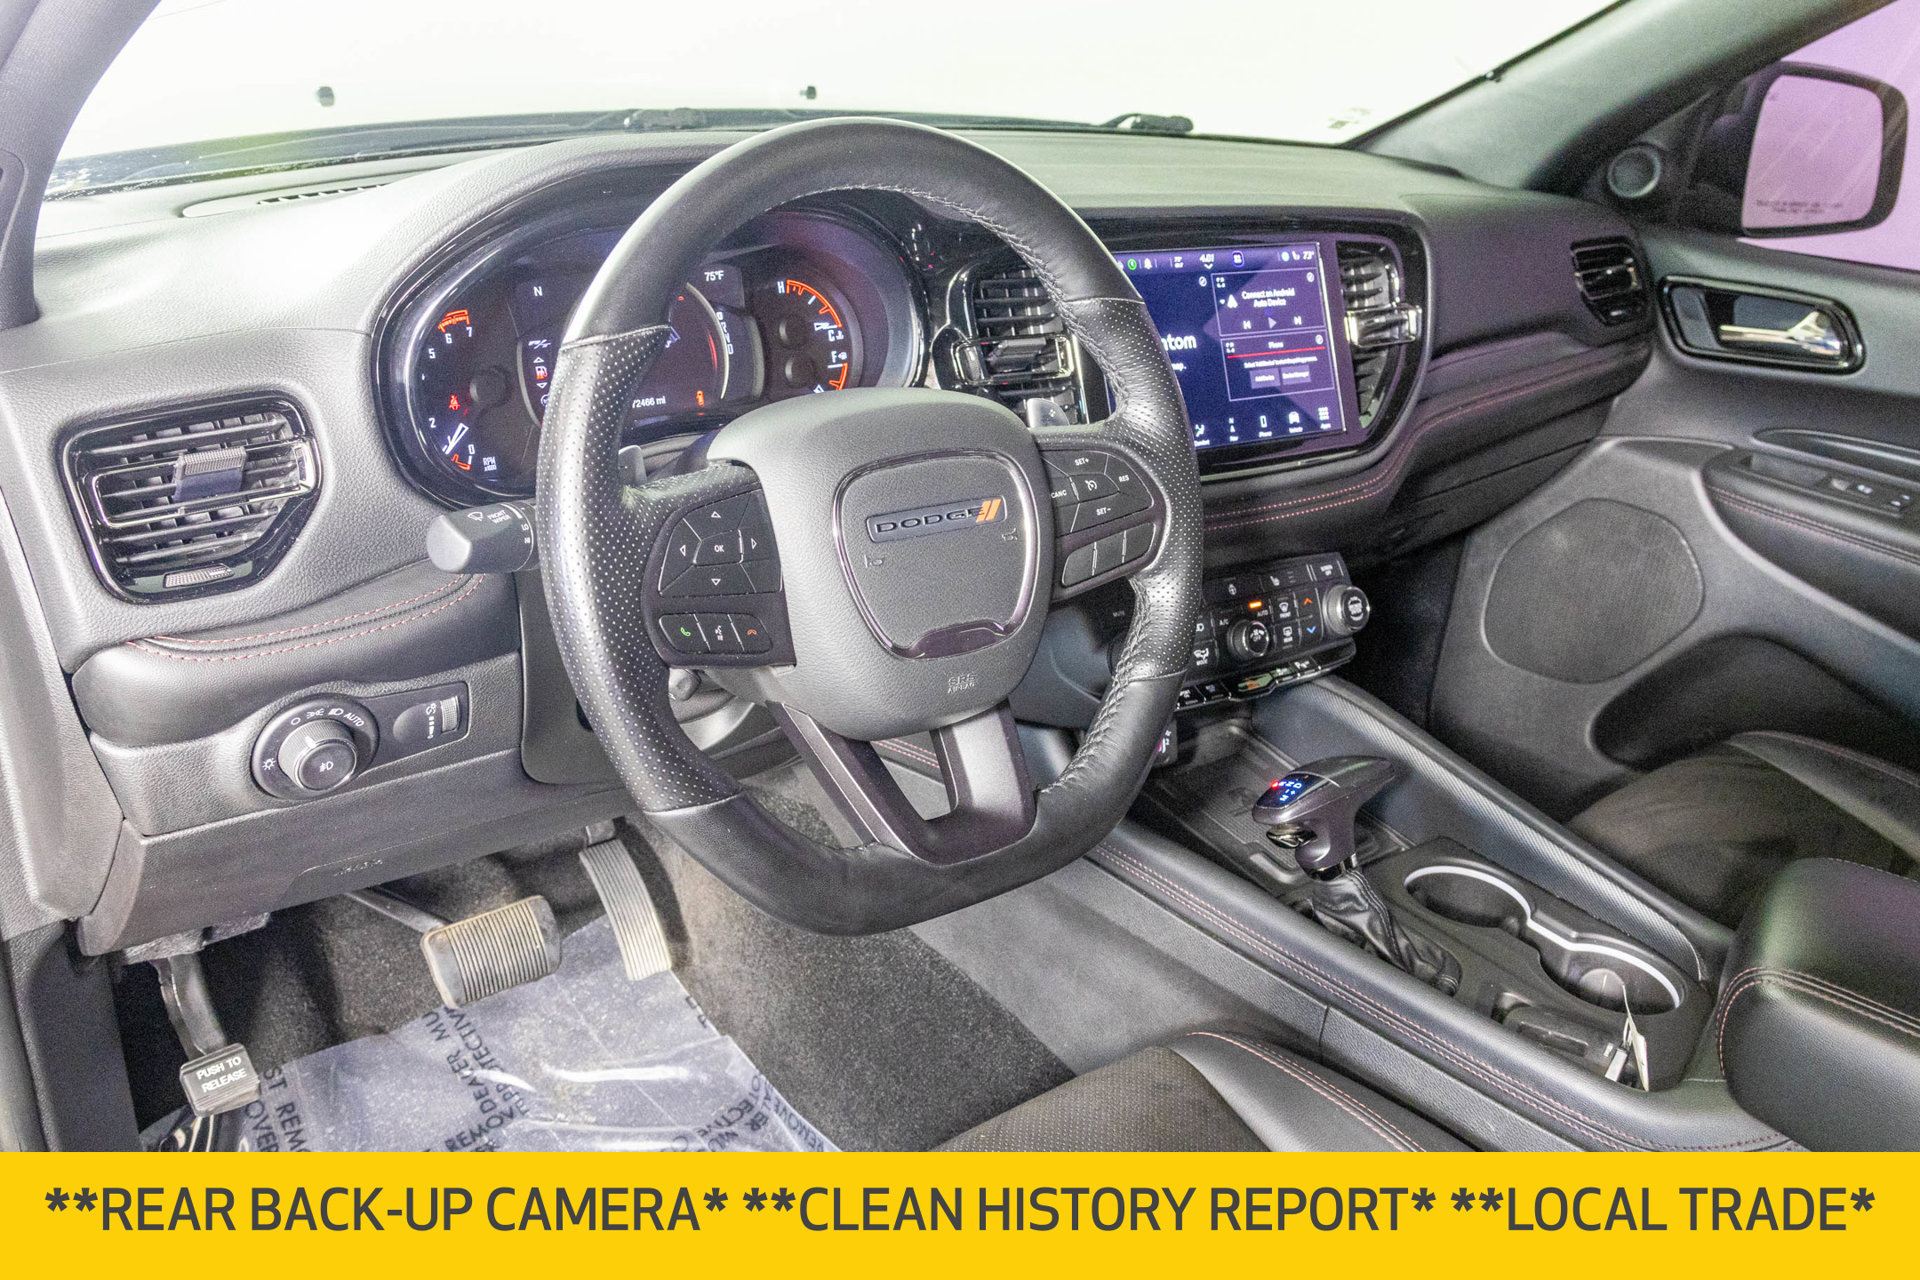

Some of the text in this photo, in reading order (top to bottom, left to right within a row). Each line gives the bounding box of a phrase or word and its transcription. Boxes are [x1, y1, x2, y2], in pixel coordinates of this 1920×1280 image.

[704, 270, 725, 281] 75°F
[533, 286, 543, 296] N
[777, 281, 785, 293] H
[466, 327, 473, 337] 7
[827, 330, 836, 342] C
[445, 333, 453, 344] 6
[428, 348, 436, 359] 5
[831, 351, 837, 363] F
[429, 418, 437, 428] 2
[468, 444, 476, 454] 0
[1051, 489, 1067, 498] CANC
[875, 504, 985, 534] DODGE
[714, 544, 725, 553] OK
[344, 712, 365, 727] AUTO
[196, 1056, 242, 1080] PUSH TO
[201, 1068, 247, 1093] RELEASE
